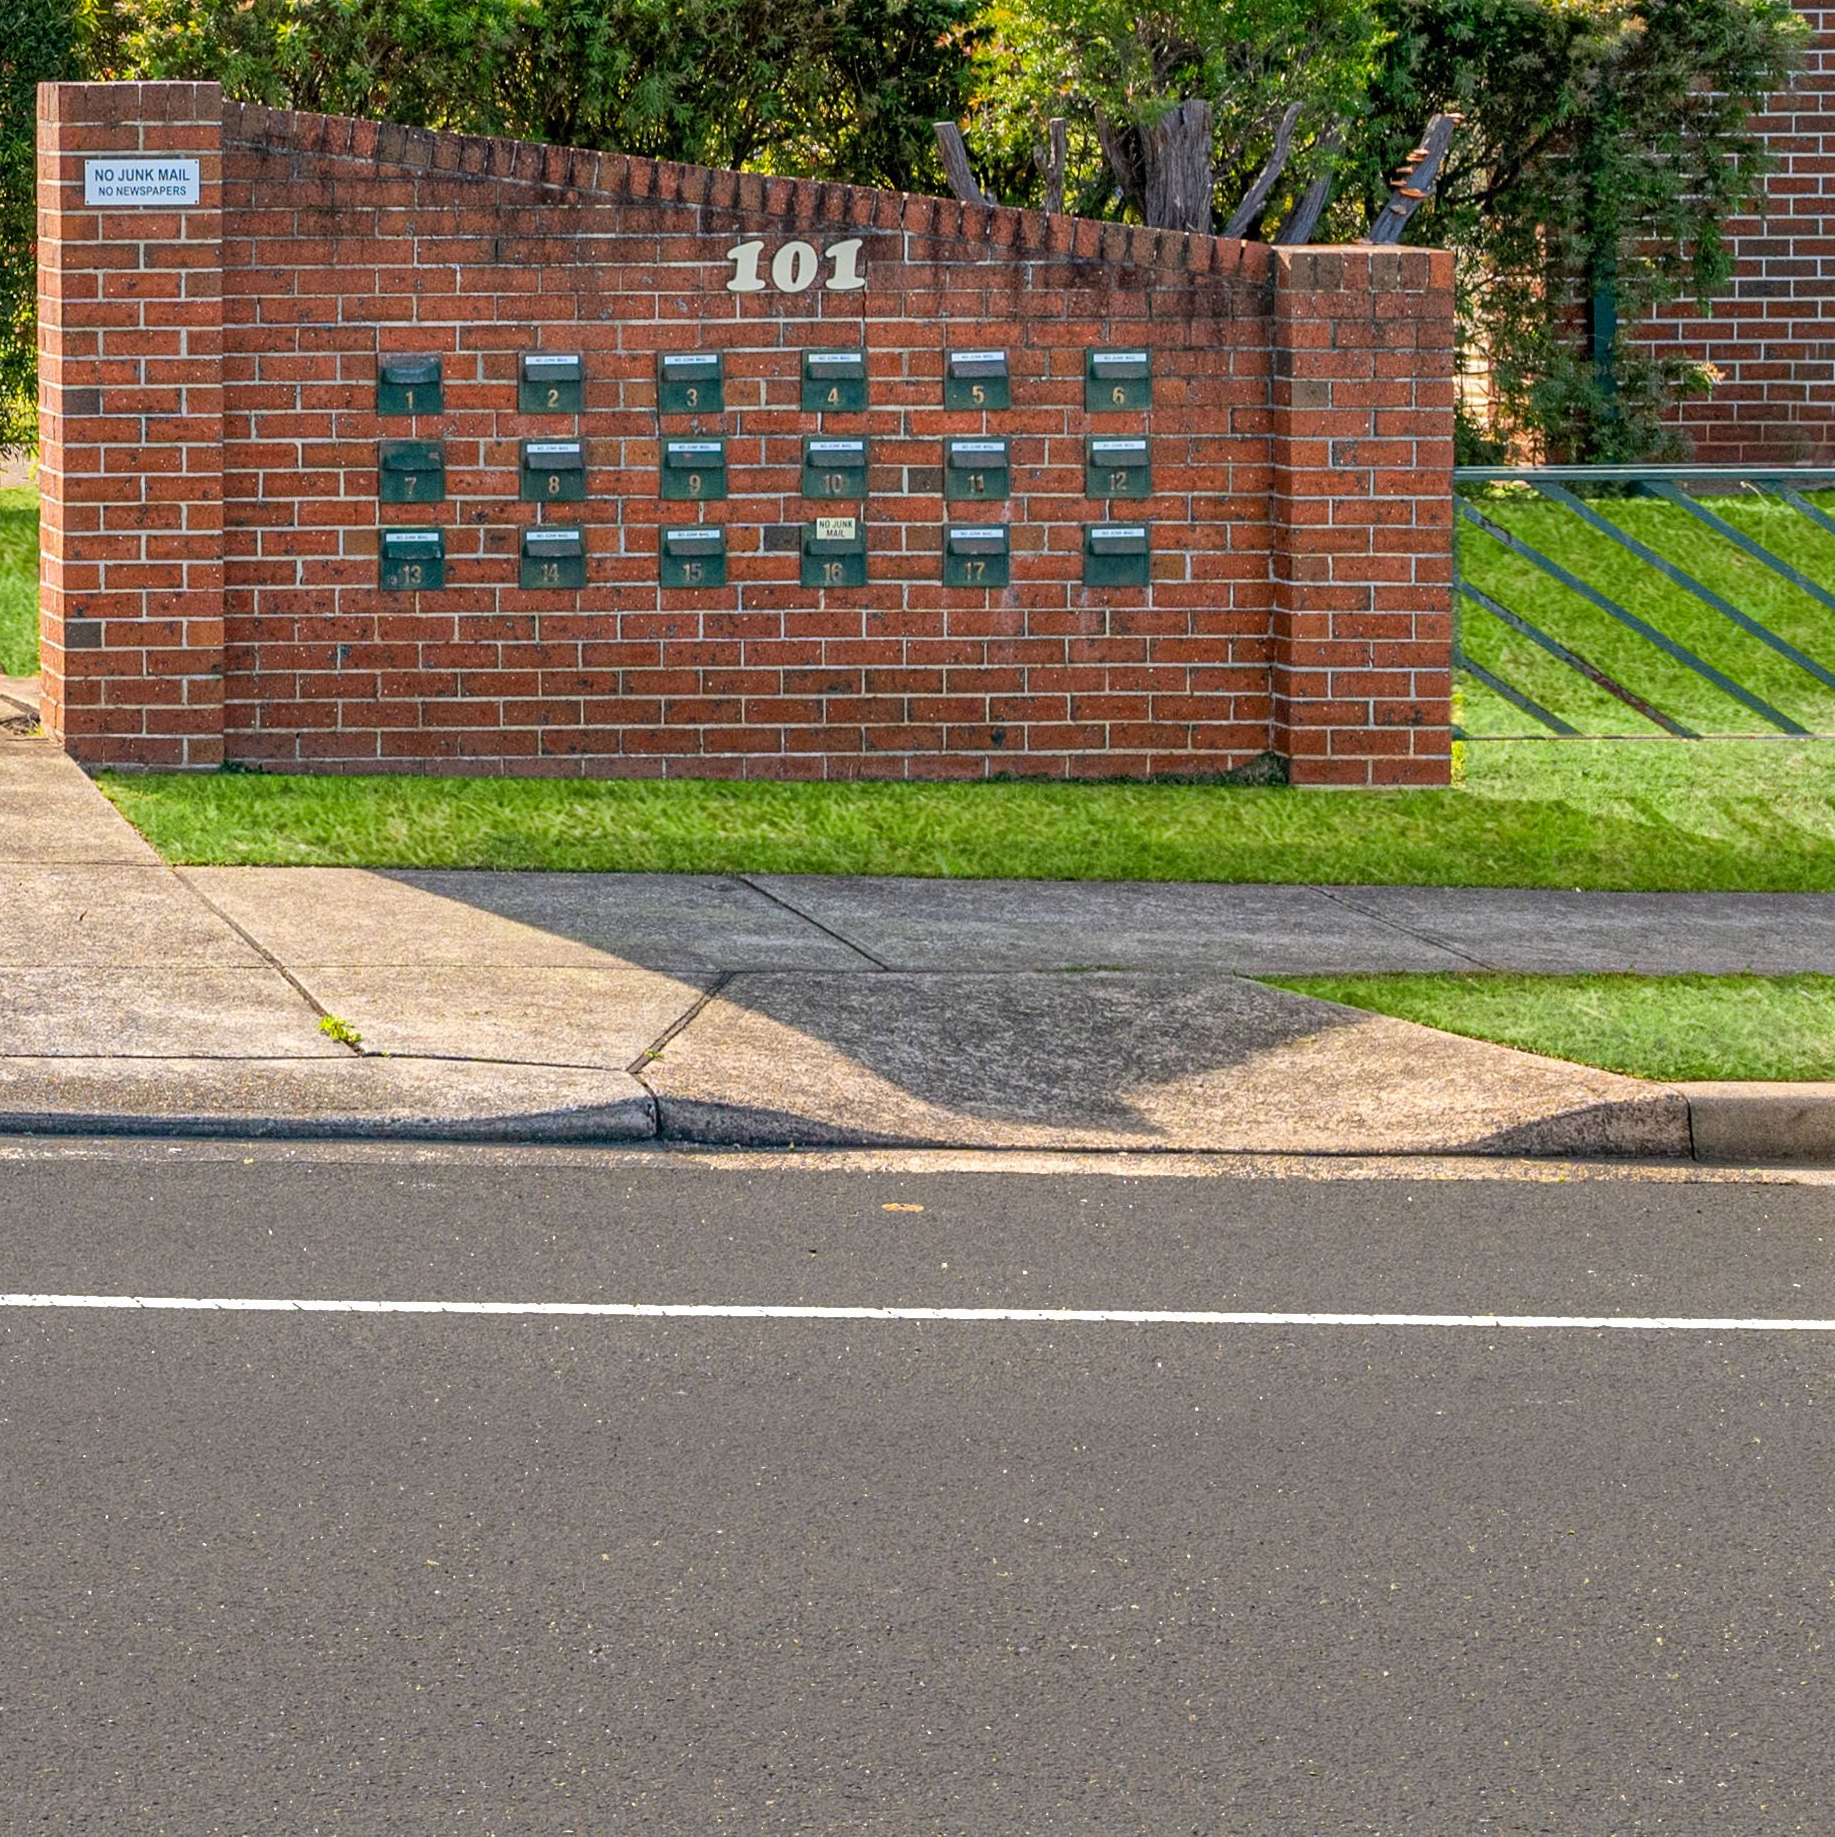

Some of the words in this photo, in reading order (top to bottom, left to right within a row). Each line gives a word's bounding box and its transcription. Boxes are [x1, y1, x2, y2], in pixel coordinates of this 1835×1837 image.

[95, 169, 115, 182] NO
[117, 169, 155, 182] JUNK
[157, 169, 190, 182] MAIL
[98, 186, 114, 196] NO
[116, 186, 187, 196] NEWSPAPERS
[726, 238, 866, 293] 101
[405, 390, 413, 409] 1
[547, 389, 559, 407] 2
[686, 388, 698, 406] 3
[827, 387, 839, 405] 4
[971, 385, 985, 403] 5
[1112, 386, 1125, 404] 6
[404, 476, 417, 495] 7
[548, 475, 560, 494] 8
[688, 474, 701, 493] 9
[822, 474, 843, 493] 10
[967, 474, 985, 493] 11
[1108, 471, 1127, 490] 12
[819, 519, 831, 529] NO
[831, 519, 853, 529] JUNK
[826, 529, 845, 537] MAIL
[402, 565, 422, 584] 13
[541, 563, 559, 582] 14
[683, 563, 703, 581] 15
[822, 563, 843, 582] 16
[964, 561, 985, 581] 17
